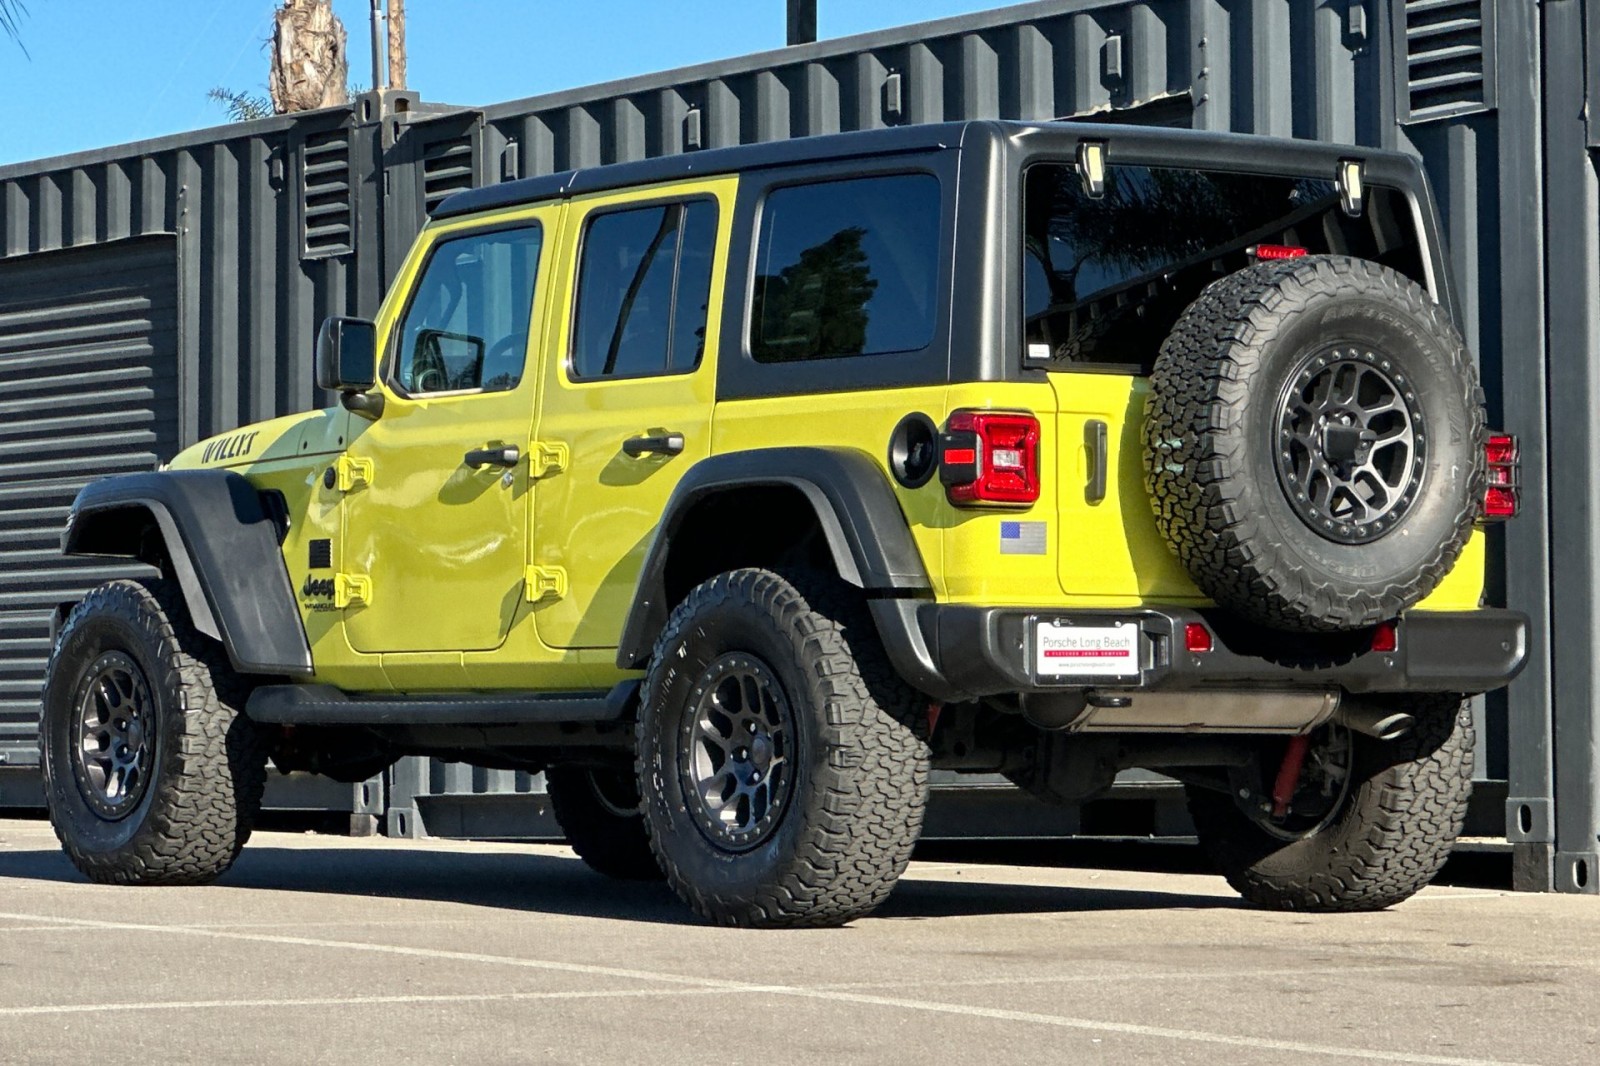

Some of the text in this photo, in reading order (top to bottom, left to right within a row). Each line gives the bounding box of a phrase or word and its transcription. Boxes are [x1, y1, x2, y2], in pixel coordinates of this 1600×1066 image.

[201, 430, 260, 464] WILLYS
[302, 573, 335, 600] Jeep
[1043, 636, 1130, 650] Porsche Long Beach
